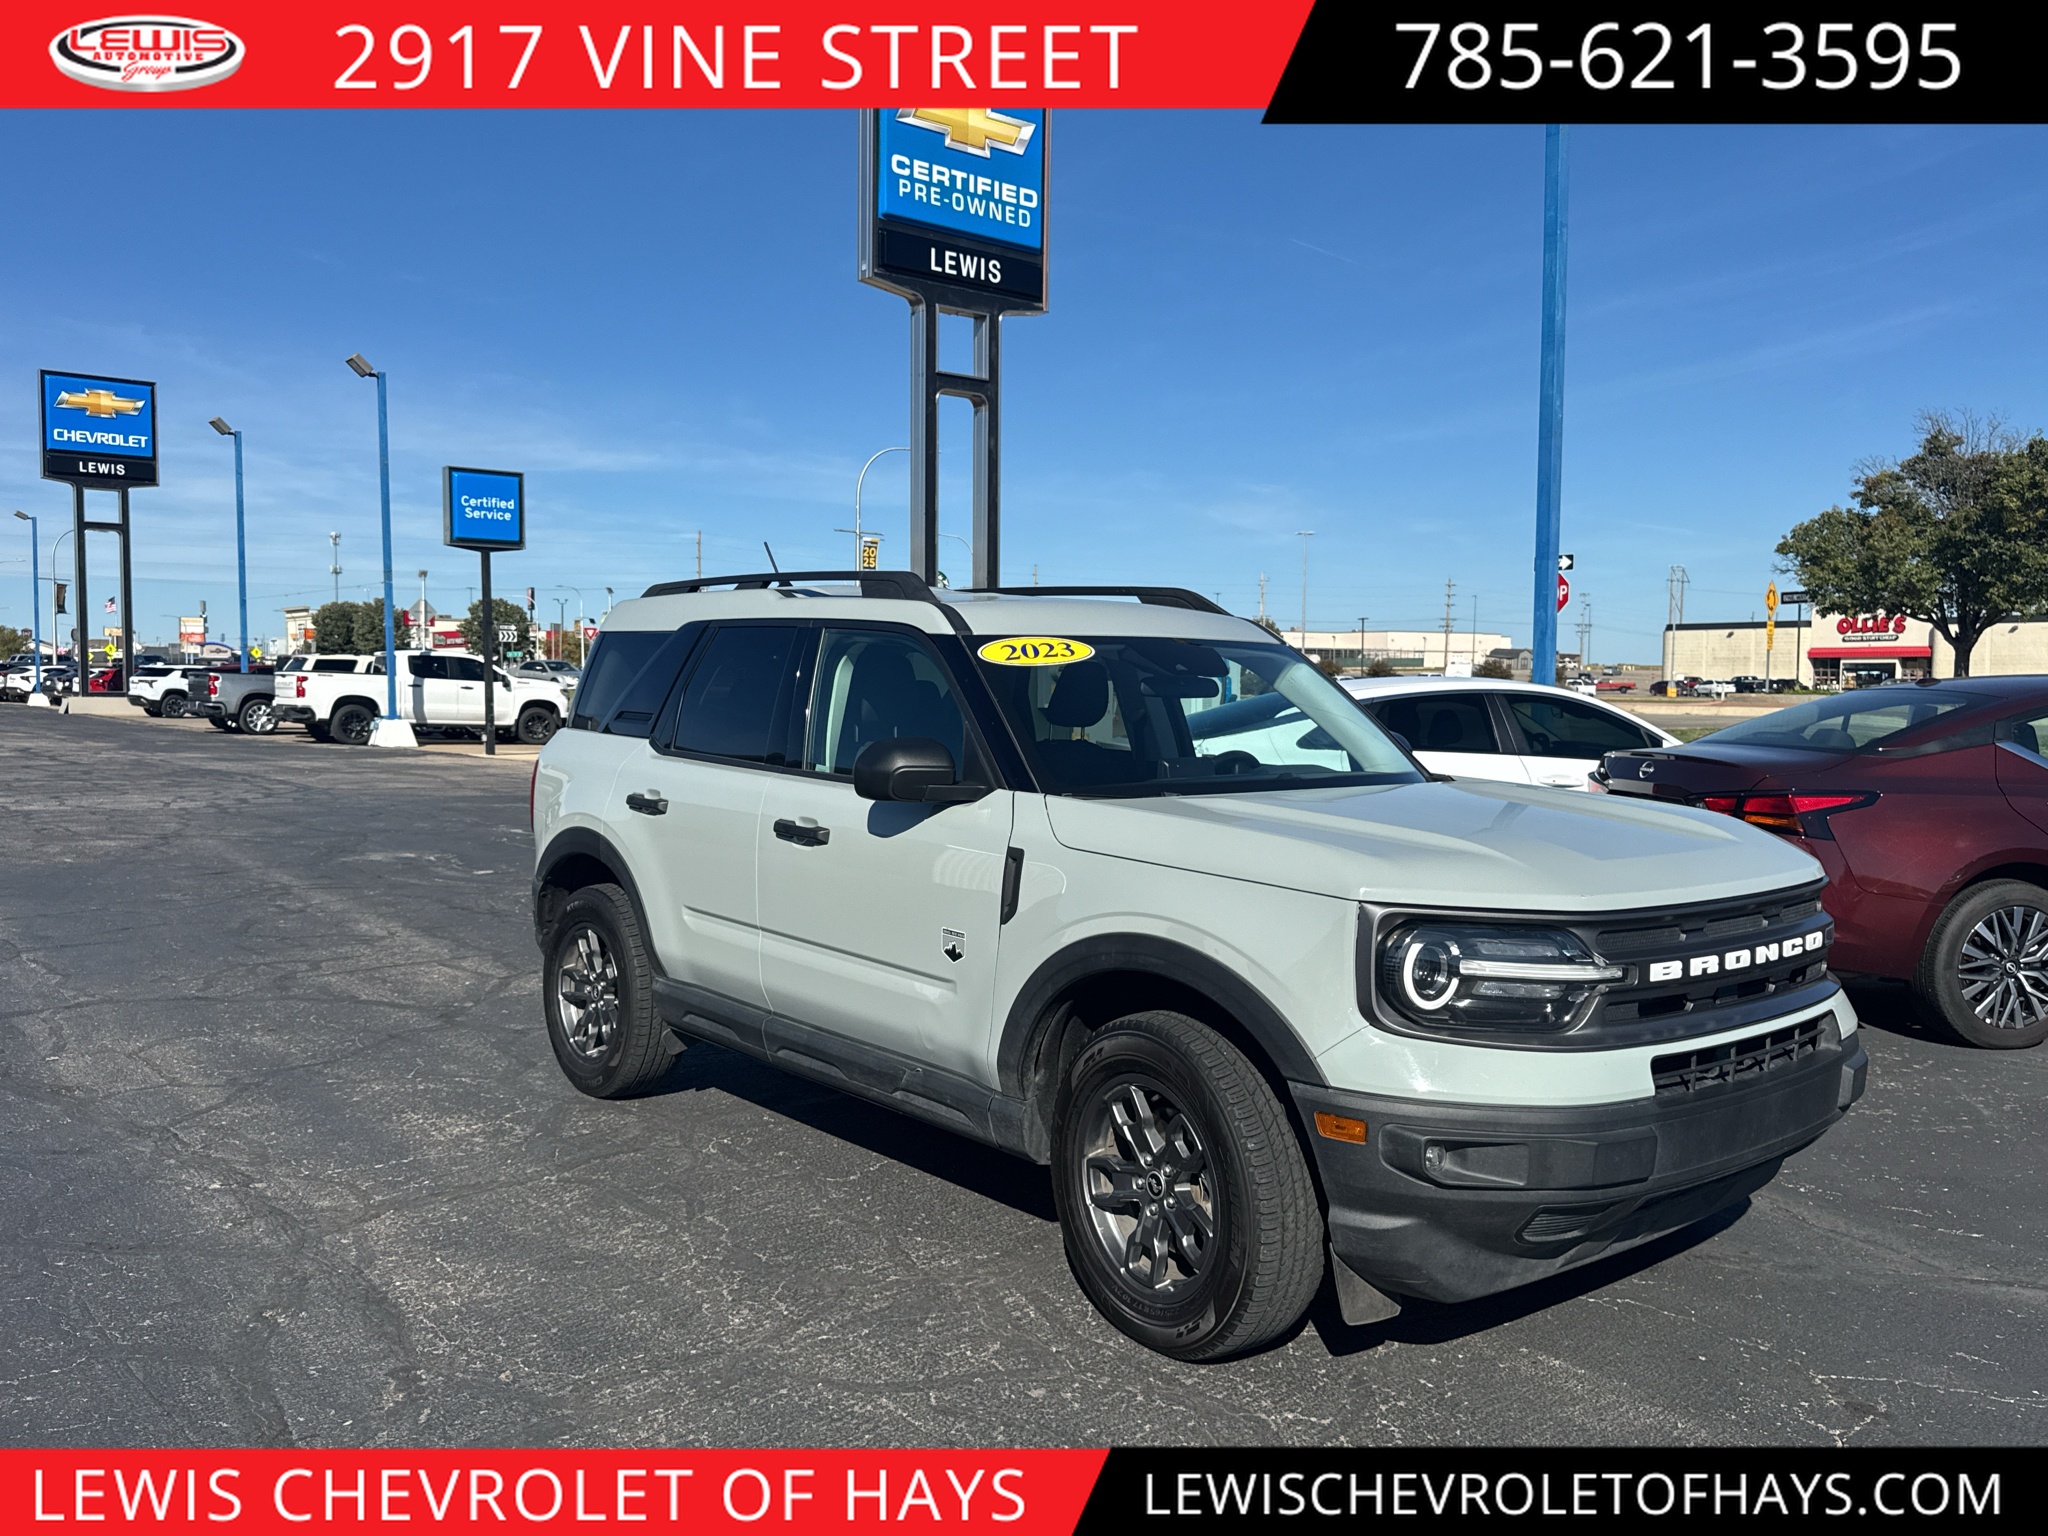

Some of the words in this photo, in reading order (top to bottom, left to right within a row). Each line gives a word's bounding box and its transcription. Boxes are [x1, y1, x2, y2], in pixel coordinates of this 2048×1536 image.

[891, 154, 1038, 208] CERTIFIED
[899, 179, 1031, 228] PRE-OWNED
[930, 247, 1002, 284] LEWIS
[53, 428, 149, 448] CHEVROLET
[79, 461, 126, 476] LEWIS
[461, 495, 515, 509] Certified
[464, 507, 512, 521] Service
[863, 546, 877, 557] 20
[863, 557, 876, 568] 25
[1837, 616, 1907, 634] OLLIE'S
[1000, 642, 1076, 661] 2023
[1649, 931, 1823, 982] BRONCO
